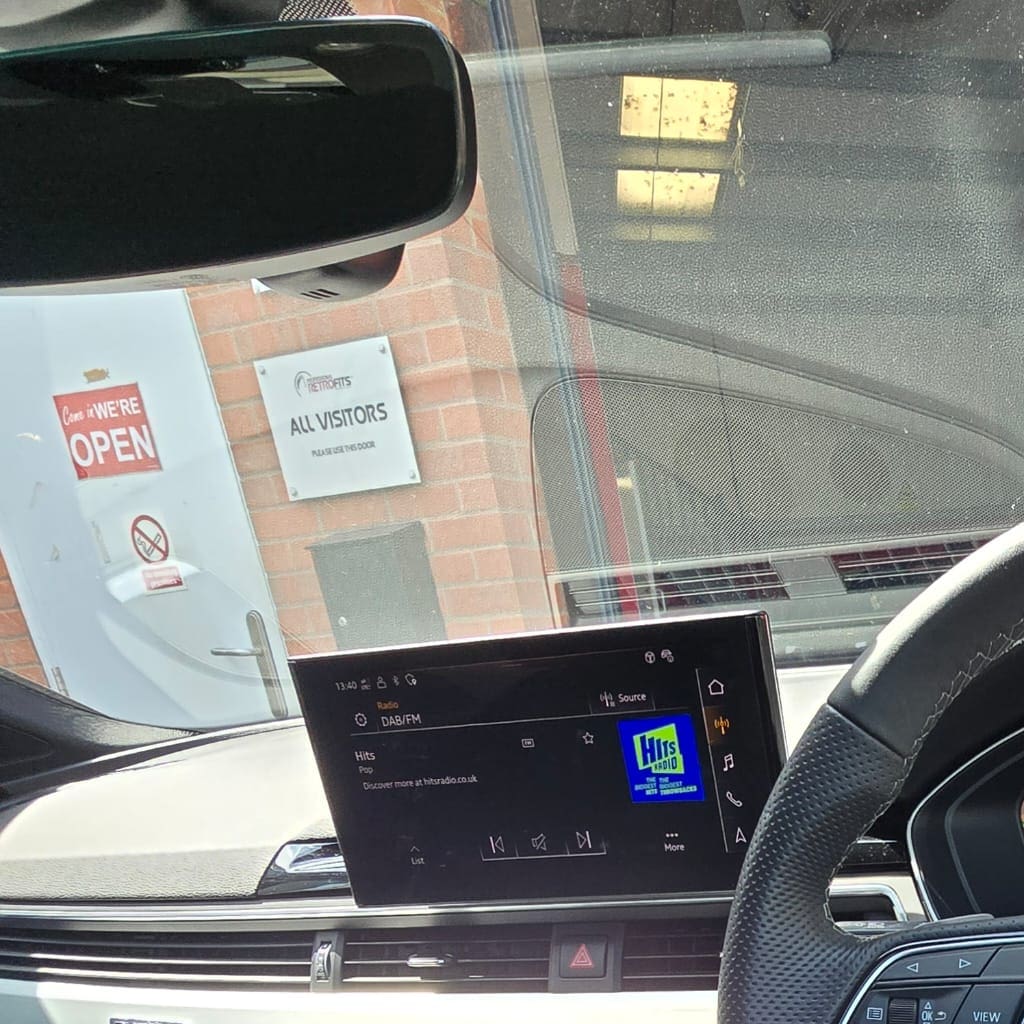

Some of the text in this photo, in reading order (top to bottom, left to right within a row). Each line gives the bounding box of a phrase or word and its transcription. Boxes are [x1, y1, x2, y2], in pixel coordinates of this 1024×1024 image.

[62, 405, 85, 426] Come
[93, 397, 141, 420] WE'RE
[291, 402, 388, 436] ALL VISITORS
[70, 425, 156, 467] OPEN
[312, 448, 333, 457] PLEASE
[358, 440, 376, 450] DOOR
[336, 681, 357, 691] 13:40
[618, 693, 647, 703] Source
[376, 701, 399, 710] Radio
[381, 713, 422, 727] DAB/FM
[355, 751, 376, 761] Hits
[654, 756, 678, 771] RADIO
[358, 766, 374, 775] Pop
[363, 781, 393, 791] Discover
[394, 780, 414, 788] more
[424, 774, 478, 786] hitsradio.co.uk
[665, 842, 685, 851] More
[411, 857, 425, 865] List
[921, 1011, 933, 1021] OK
[973, 1011, 1001, 1022] VIEW
